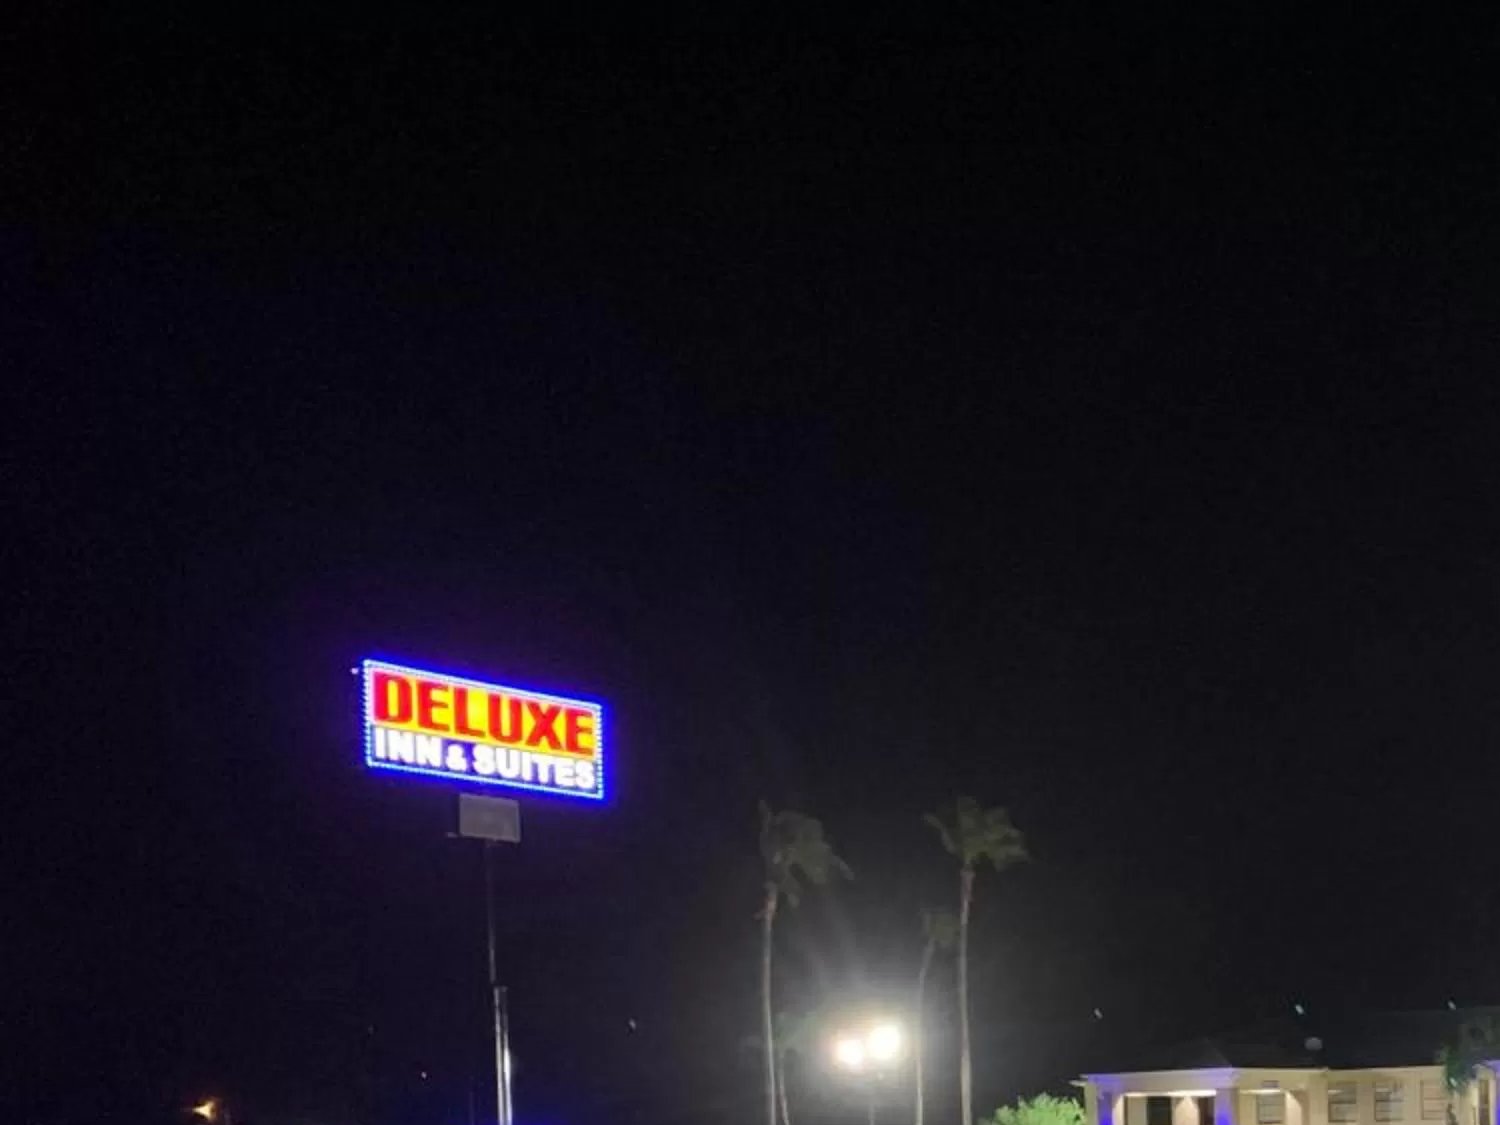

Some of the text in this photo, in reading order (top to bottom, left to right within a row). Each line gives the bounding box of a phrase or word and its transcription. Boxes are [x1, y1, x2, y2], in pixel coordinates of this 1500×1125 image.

[372, 670, 594, 756] DELUXE
[375, 727, 596, 790] INN & SUITES
